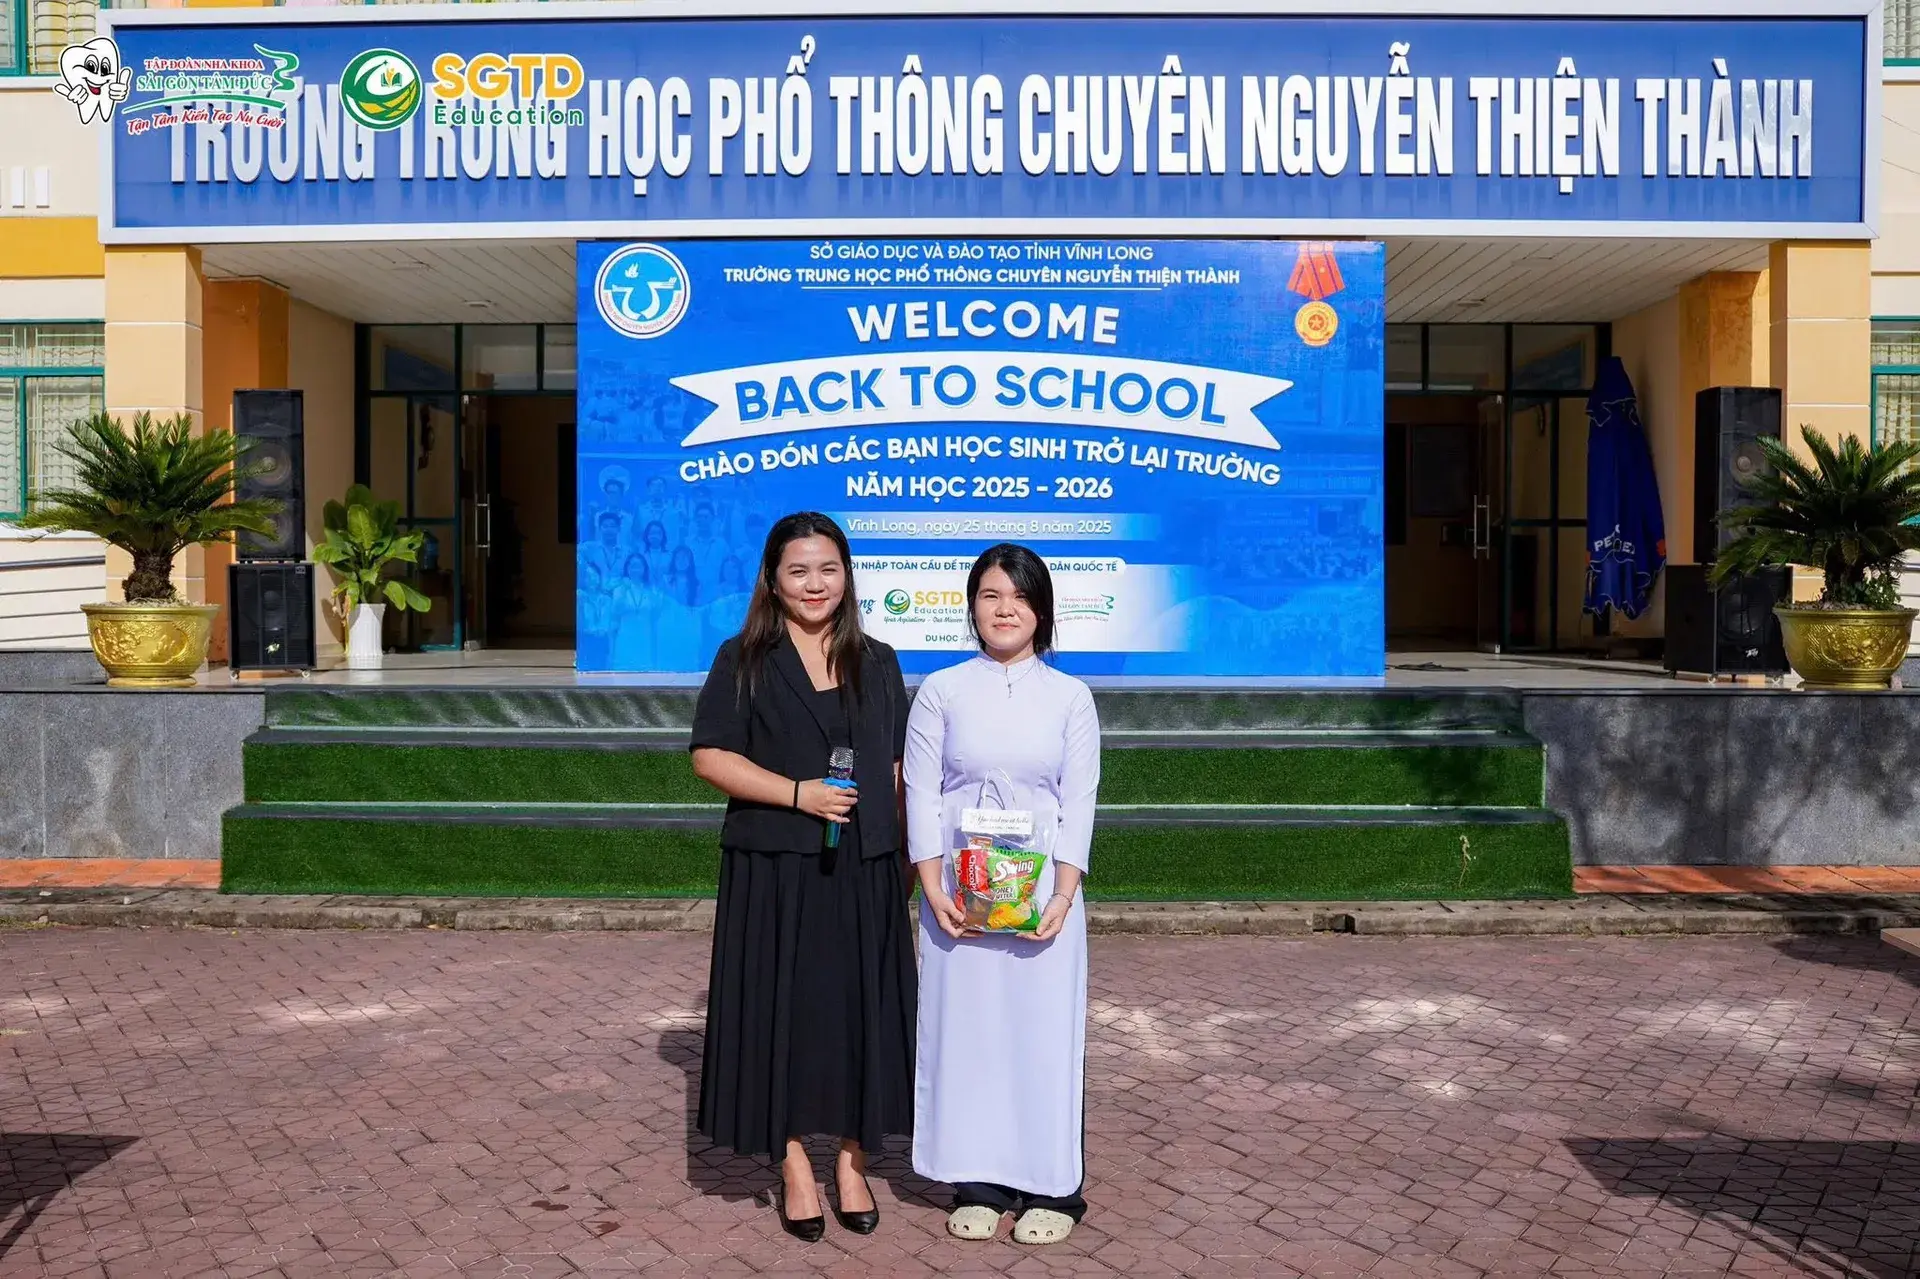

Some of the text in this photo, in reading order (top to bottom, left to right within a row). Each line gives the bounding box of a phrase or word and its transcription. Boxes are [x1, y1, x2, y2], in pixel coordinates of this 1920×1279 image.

[588, 76, 692, 196] HỌC
[708, 35, 817, 177] PHỔ
[829, 54, 1003, 176] THÔNG
[1018, 54, 1227, 177] CHUYÊN
[1241, 41, 1455, 177] NGUYỄN
[1469, 56, 1620, 194] THIỆN
[1635, 58, 1814, 178] THÀNH
[810, 240, 1154, 263] SỞ GIÁO DỤC VÀ ĐÀO TẠO TỈNH VĨNH LONG
[723, 264, 1240, 287] TRƯỜNG TRUNG HỌC PHỔ THÔNG CHUYÊN NGUYỄN THIỆN THÀNH
[847, 300, 1120, 344] WELCOME
[735, 365, 1226, 425] BACK TO SCHOOL
[680, 435, 1281, 485] CHÀO ĐÓN CÁC BẠN HỌC SINH TRỞ LẠI TRƯỜNG
[847, 471, 903, 498] NĂM
[910, 476, 966, 503] HỌC
[972, 476, 1030, 498] 2025
[1054, 477, 1113, 499] 2026
[848, 519, 1112, 535] Vĩnh Long, ngày 25 tháng 8 năm 2025
[861, 560, 888, 572] NHẬP
[890, 560, 918, 570] TOÀN
[1073, 560, 1104, 572] QUỐC
[1106, 560, 1118, 571] TẾ
[914, 591, 964, 606] SGTD
[925, 634, 938, 642] DU
[992, 860, 1034, 882] Swing
[994, 886, 1014, 894] ONEY
